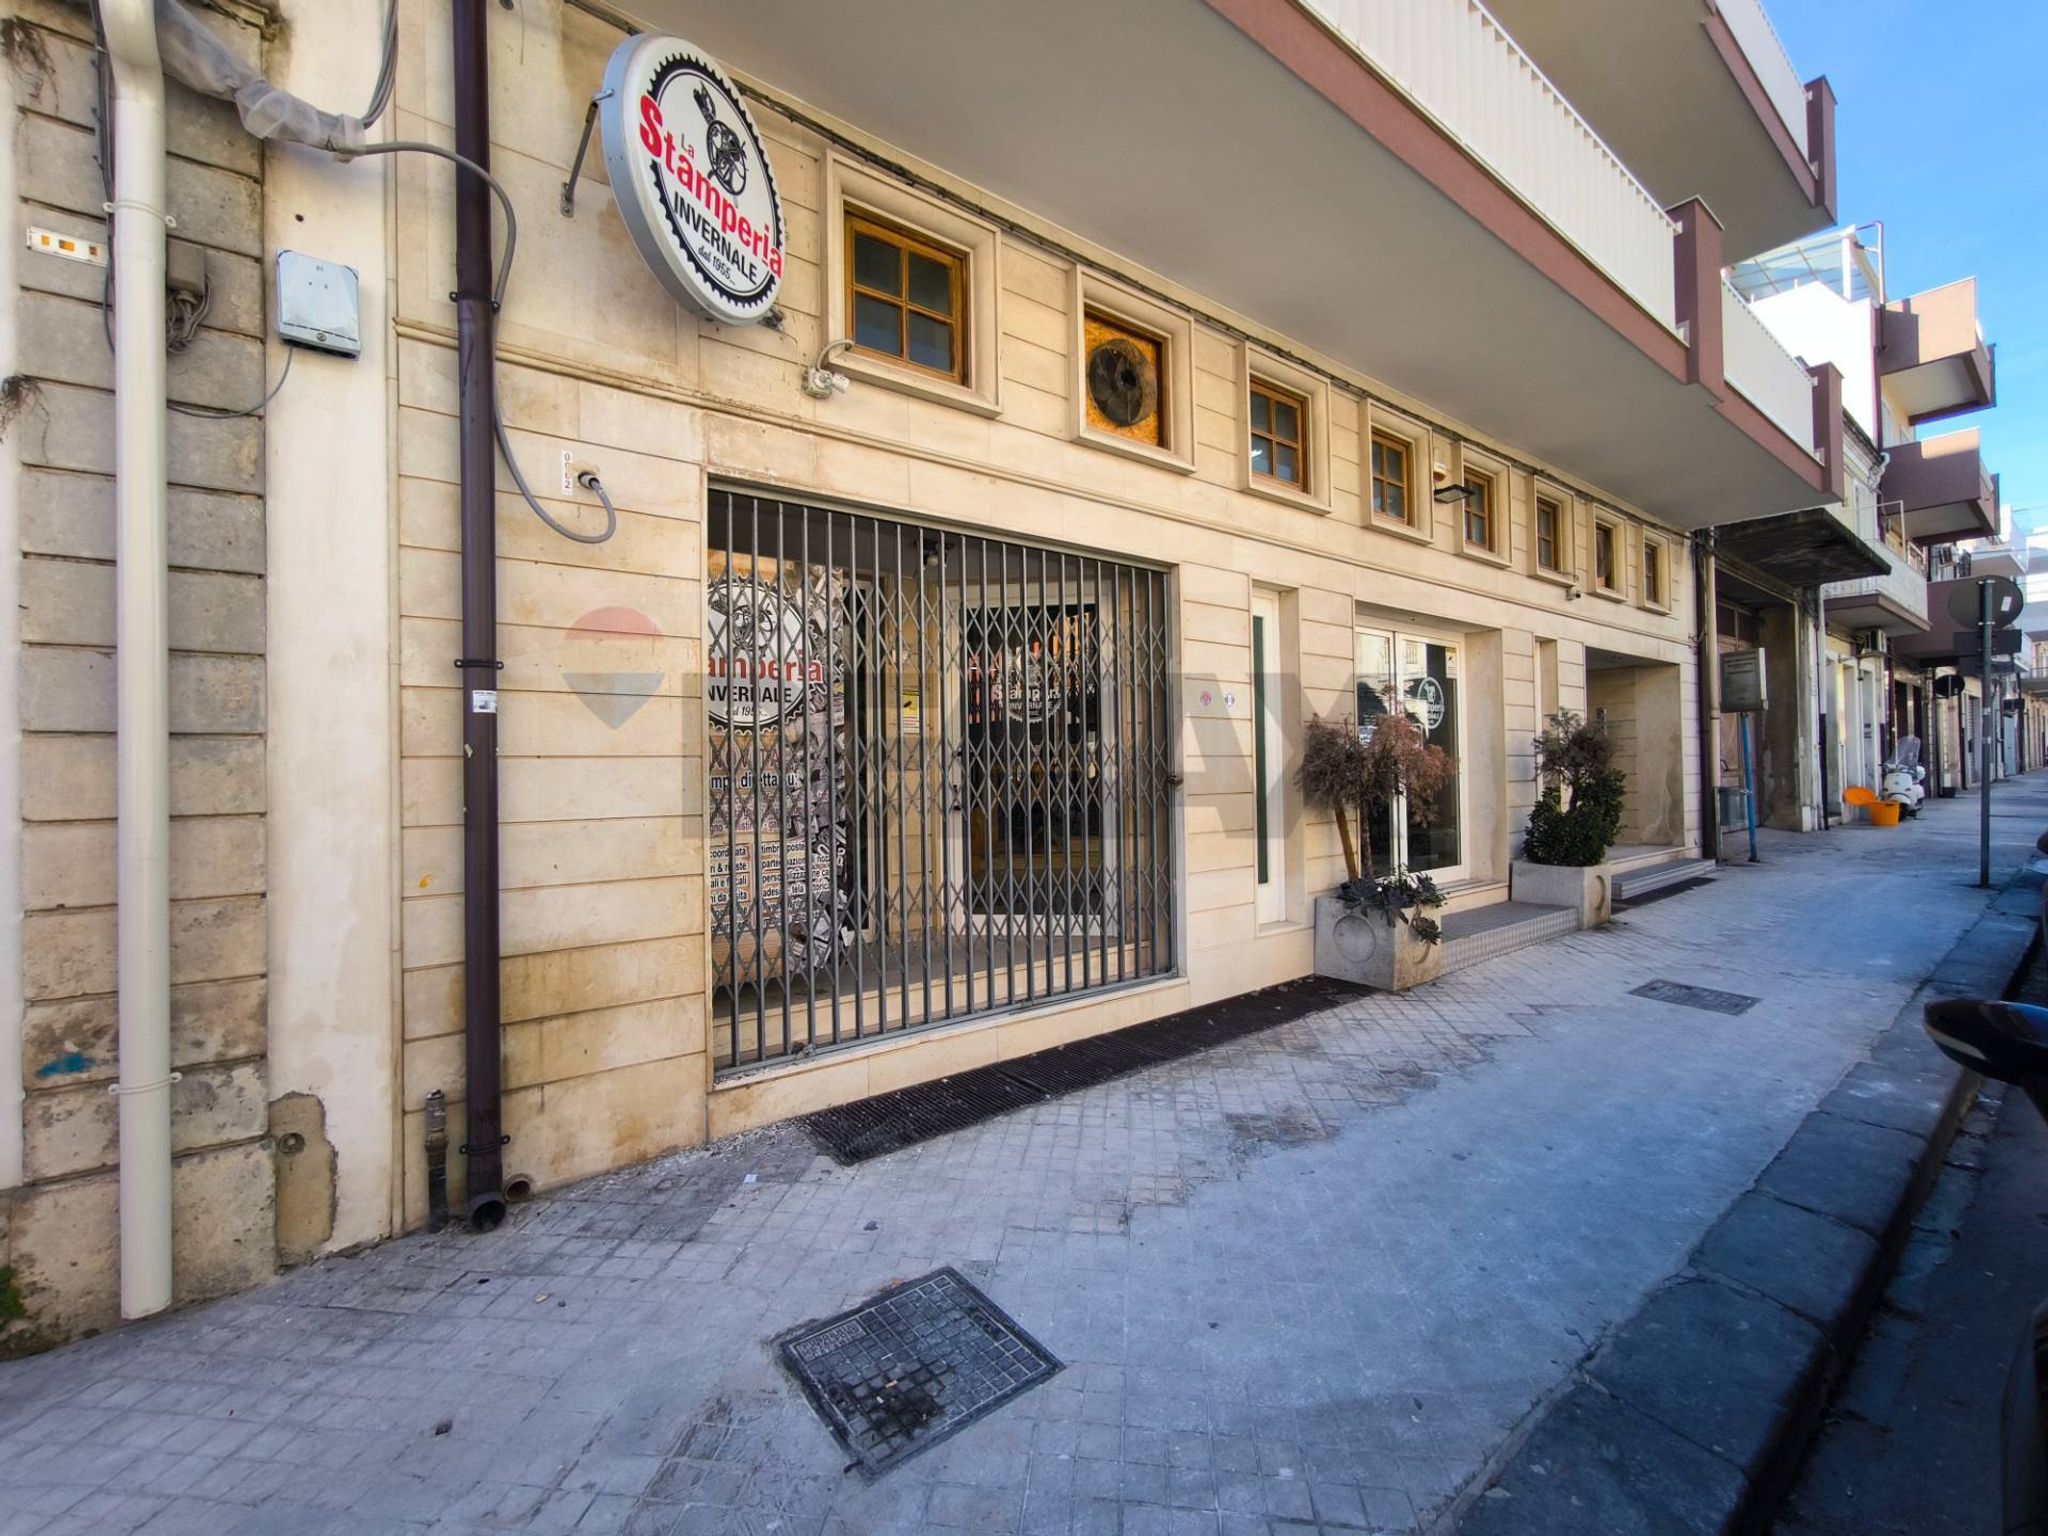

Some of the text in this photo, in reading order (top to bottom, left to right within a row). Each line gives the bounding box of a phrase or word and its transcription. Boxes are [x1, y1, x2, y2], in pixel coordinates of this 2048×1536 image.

[681, 133, 695, 159] La
[639, 94, 783, 280] Stamperia
[674, 191, 757, 286] INVERNALE
[698, 245, 711, 264] dal
